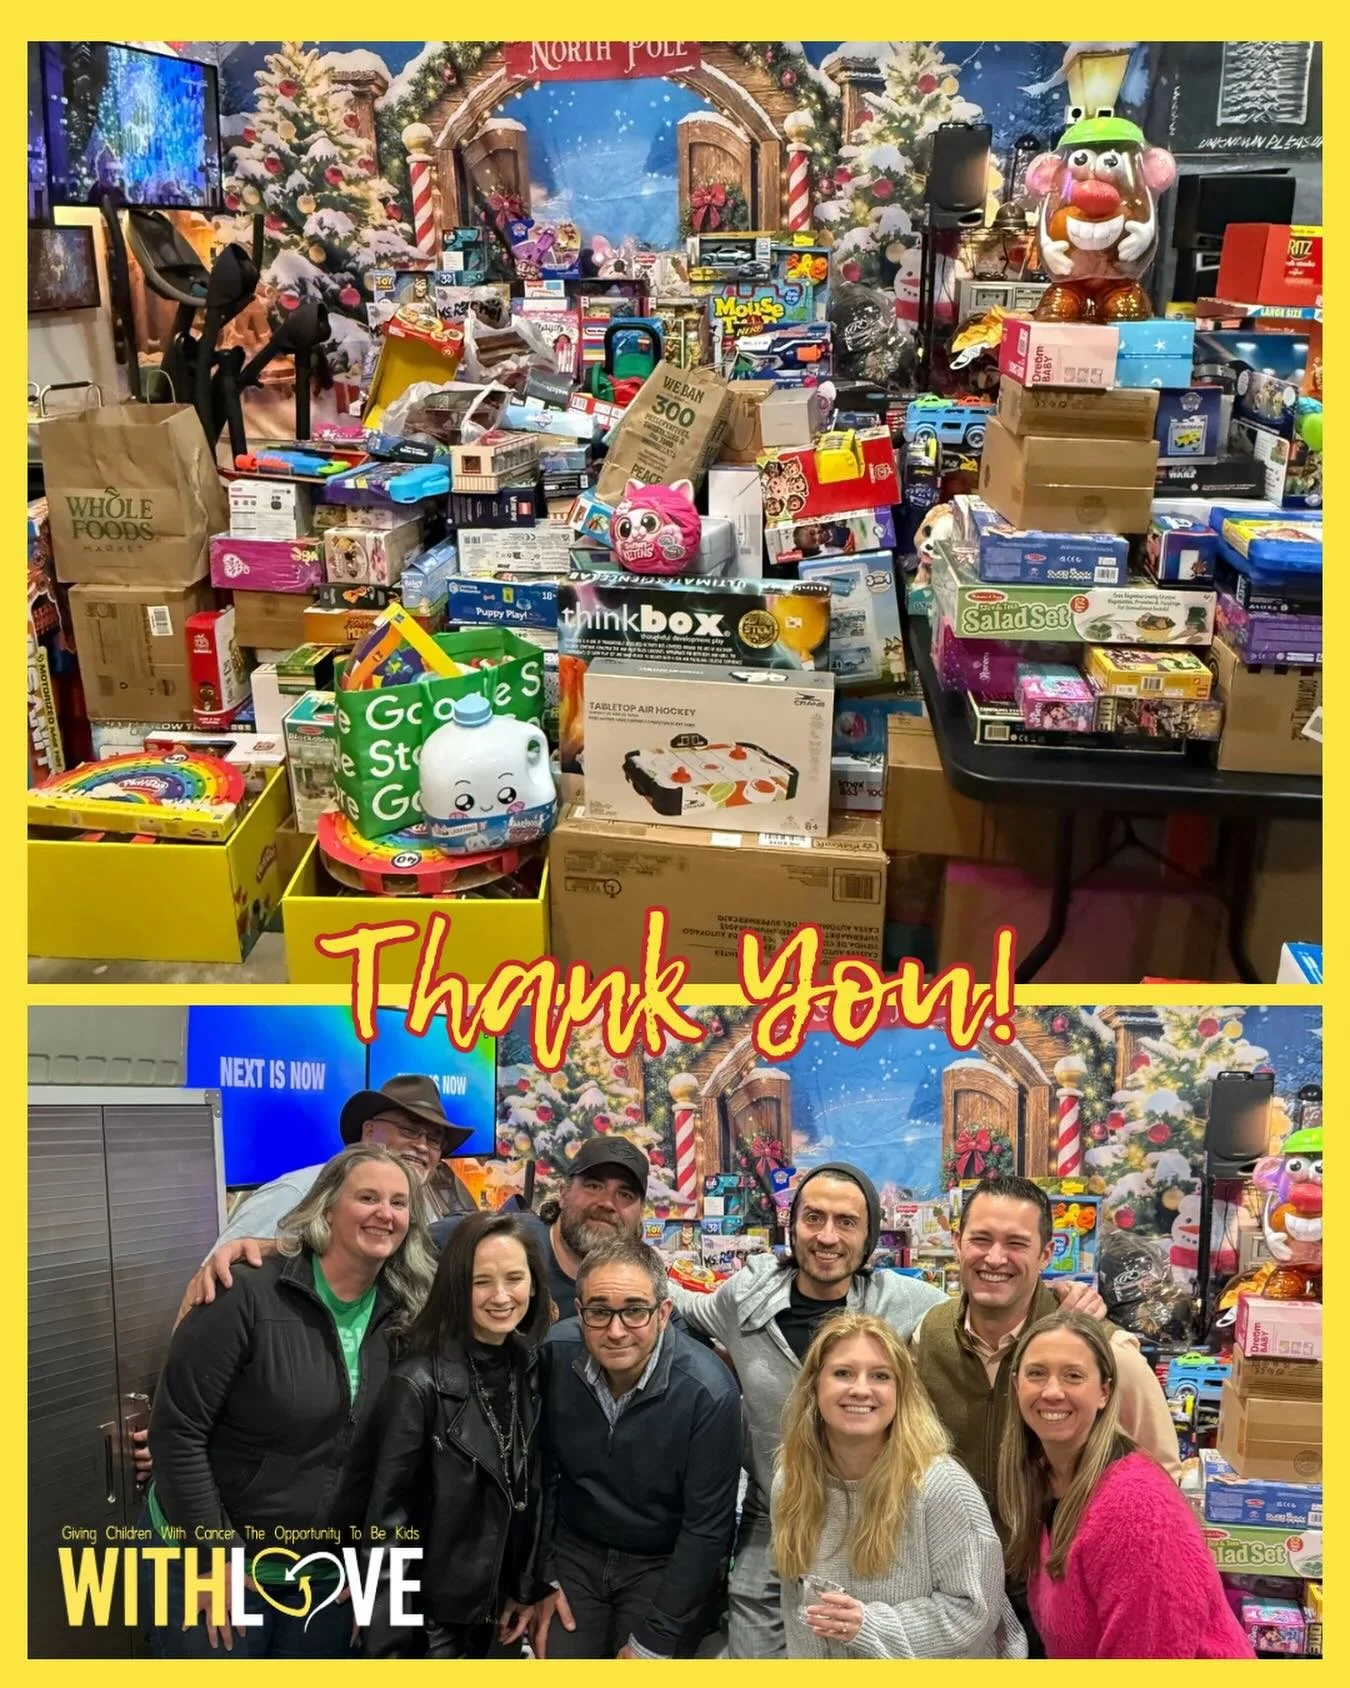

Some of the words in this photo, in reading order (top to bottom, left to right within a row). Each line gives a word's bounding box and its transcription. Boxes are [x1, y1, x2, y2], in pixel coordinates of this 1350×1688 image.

[528, 41, 612, 74] NORTH
[624, 41, 688, 74] POLE
[1198, 135, 1265, 150] UNKNOWN
[1288, 239, 1313, 256] RITZ
[375, 276, 393, 286] TOY
[663, 376, 682, 395] WE
[680, 383, 705, 405] BAN
[651, 394, 696, 428] 300
[631, 464, 663, 483] PEACE
[64, 494, 155, 519] WHOLE
[71, 519, 155, 541] FOODS
[476, 607, 504, 619] Puppy
[506, 609, 528, 621] Play!
[561, 601, 726, 638] thinkbox
[964, 605, 1030, 633] Salad
[1030, 605, 1070, 628] Set
[38, 664, 56, 727] MOTORIZED
[589, 701, 637, 712] TABLETOP
[637, 703, 656, 714] AIR
[656, 705, 697, 717] HOCKEY
[219, 1056, 266, 1089] NEXT
[269, 1059, 286, 1089] IS
[289, 1060, 326, 1091] NOW
[442, 1075, 468, 1096] NOW
[645, 1224, 662, 1234] TOY
[1250, 1542, 1286, 1565] Set
